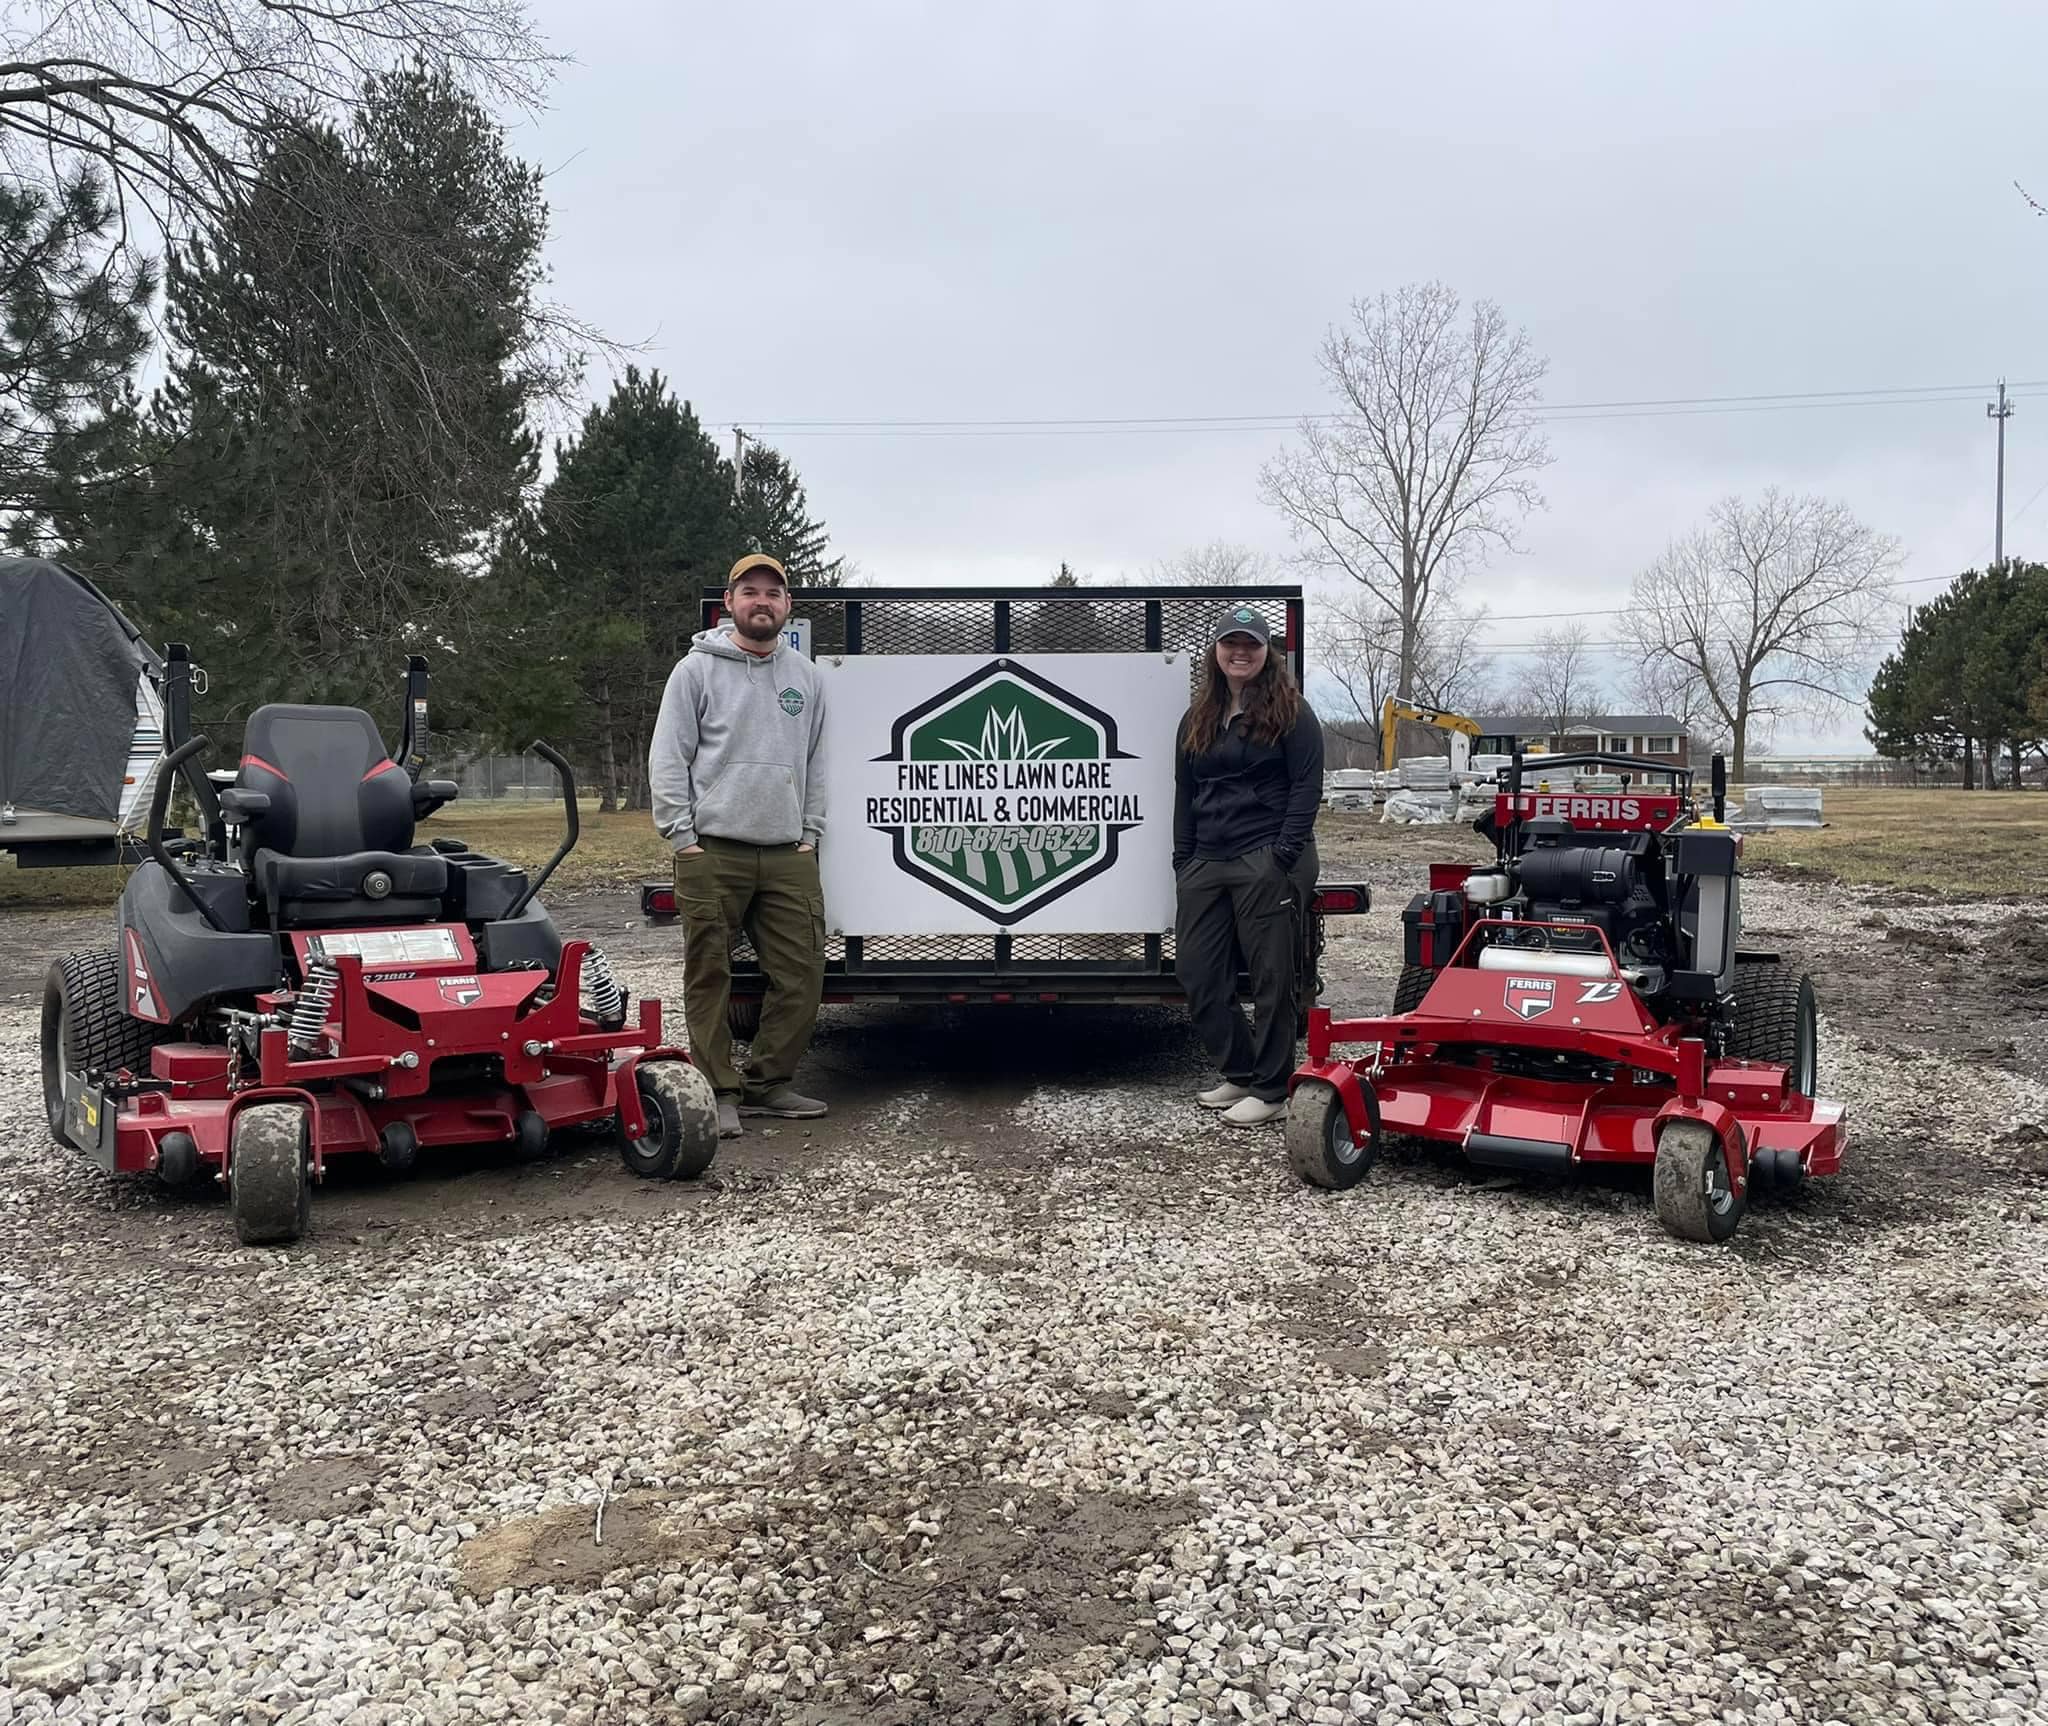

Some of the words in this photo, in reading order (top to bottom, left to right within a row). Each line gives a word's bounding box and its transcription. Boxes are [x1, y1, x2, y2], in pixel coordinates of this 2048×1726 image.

[898, 764, 939, 791] FINE
[944, 763, 998, 791] LINES
[1004, 763, 1057, 790] LAWN
[1062, 762, 1112, 789] CARE
[866, 796, 988, 823] RESIDENTIAL
[994, 796, 1011, 823] &
[1017, 795, 1145, 823] COMMERCIAL
[1535, 798, 1640, 820] FERRIS
[916, 825, 1096, 854] 810-875-0322
[439, 976, 477, 987] FERRIS
[1509, 979, 1553, 991] FERRIS
